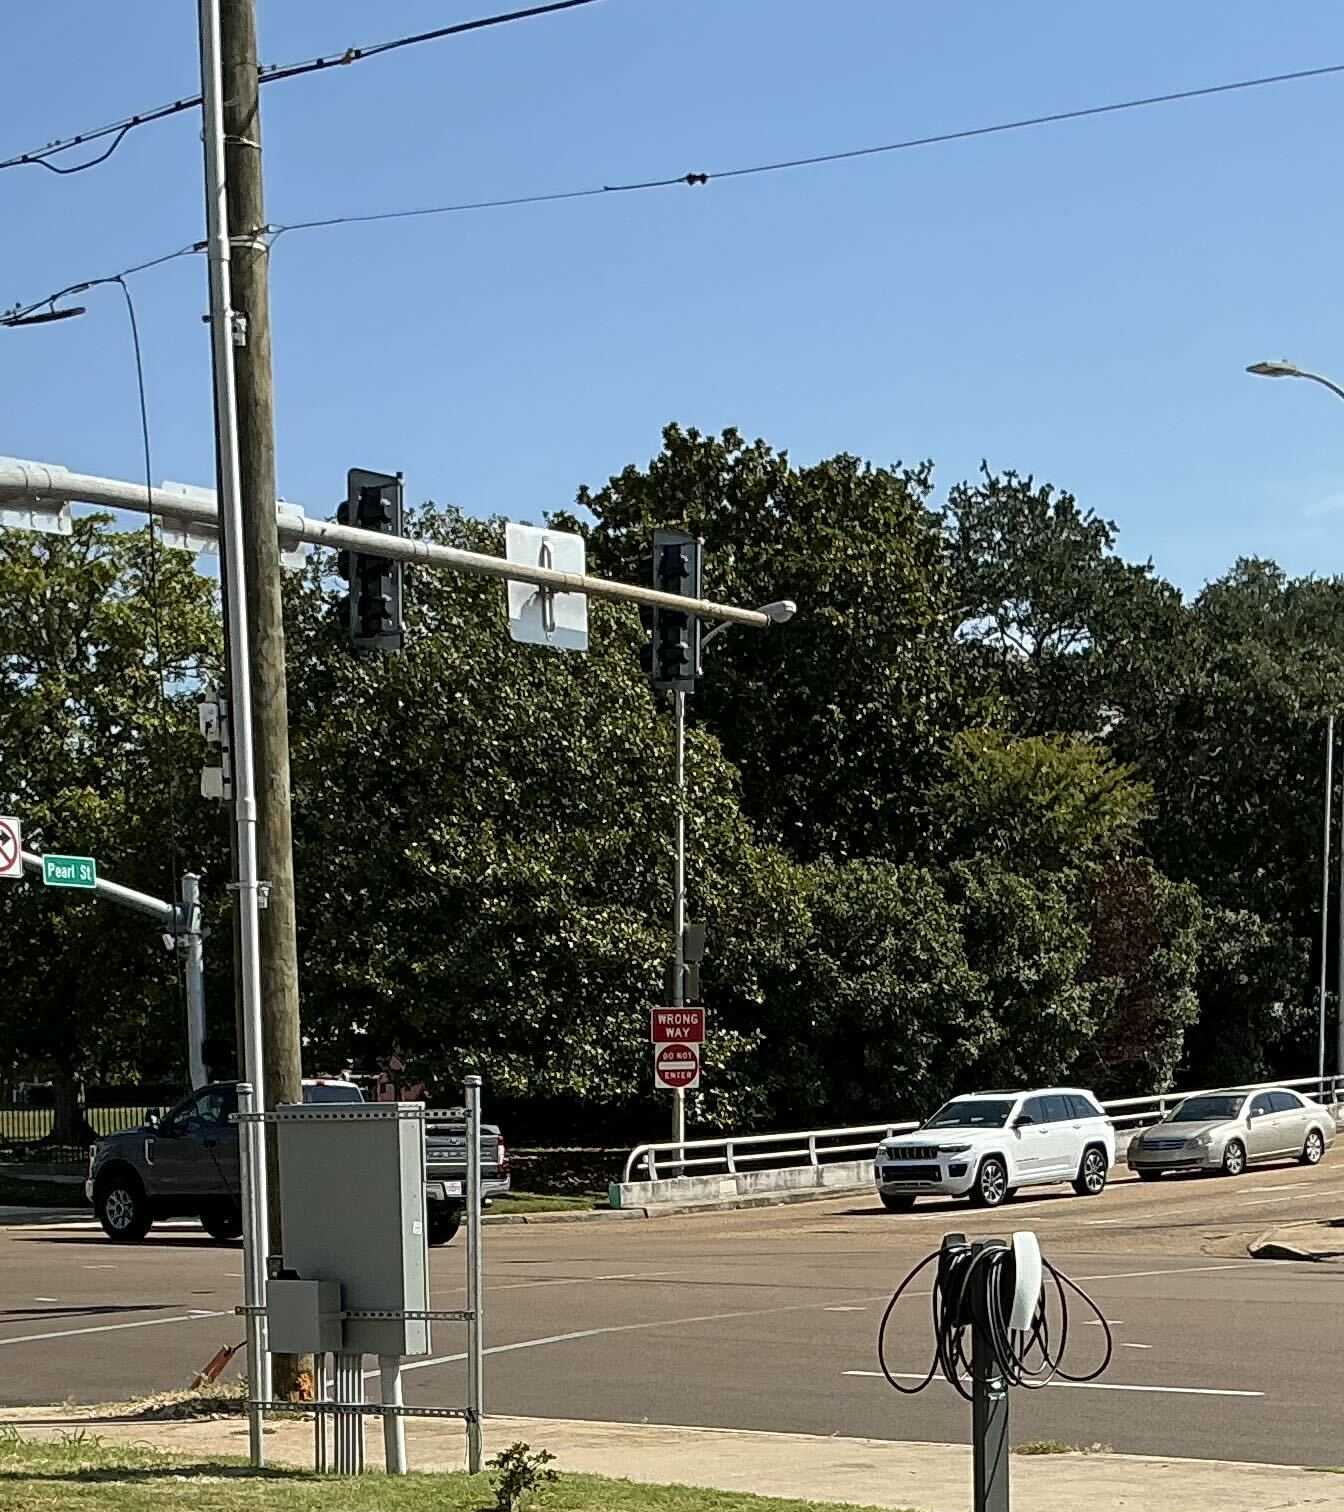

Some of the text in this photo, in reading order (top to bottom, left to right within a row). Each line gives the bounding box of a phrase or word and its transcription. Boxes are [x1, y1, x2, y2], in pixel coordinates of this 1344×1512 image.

[47, 862, 92, 881] Pearl St
[658, 1014, 699, 1025] WRONG
[665, 1027, 690, 1038] WAY
[662, 1051, 692, 1060] DO NOT
[664, 1071, 692, 1080] ENTER
